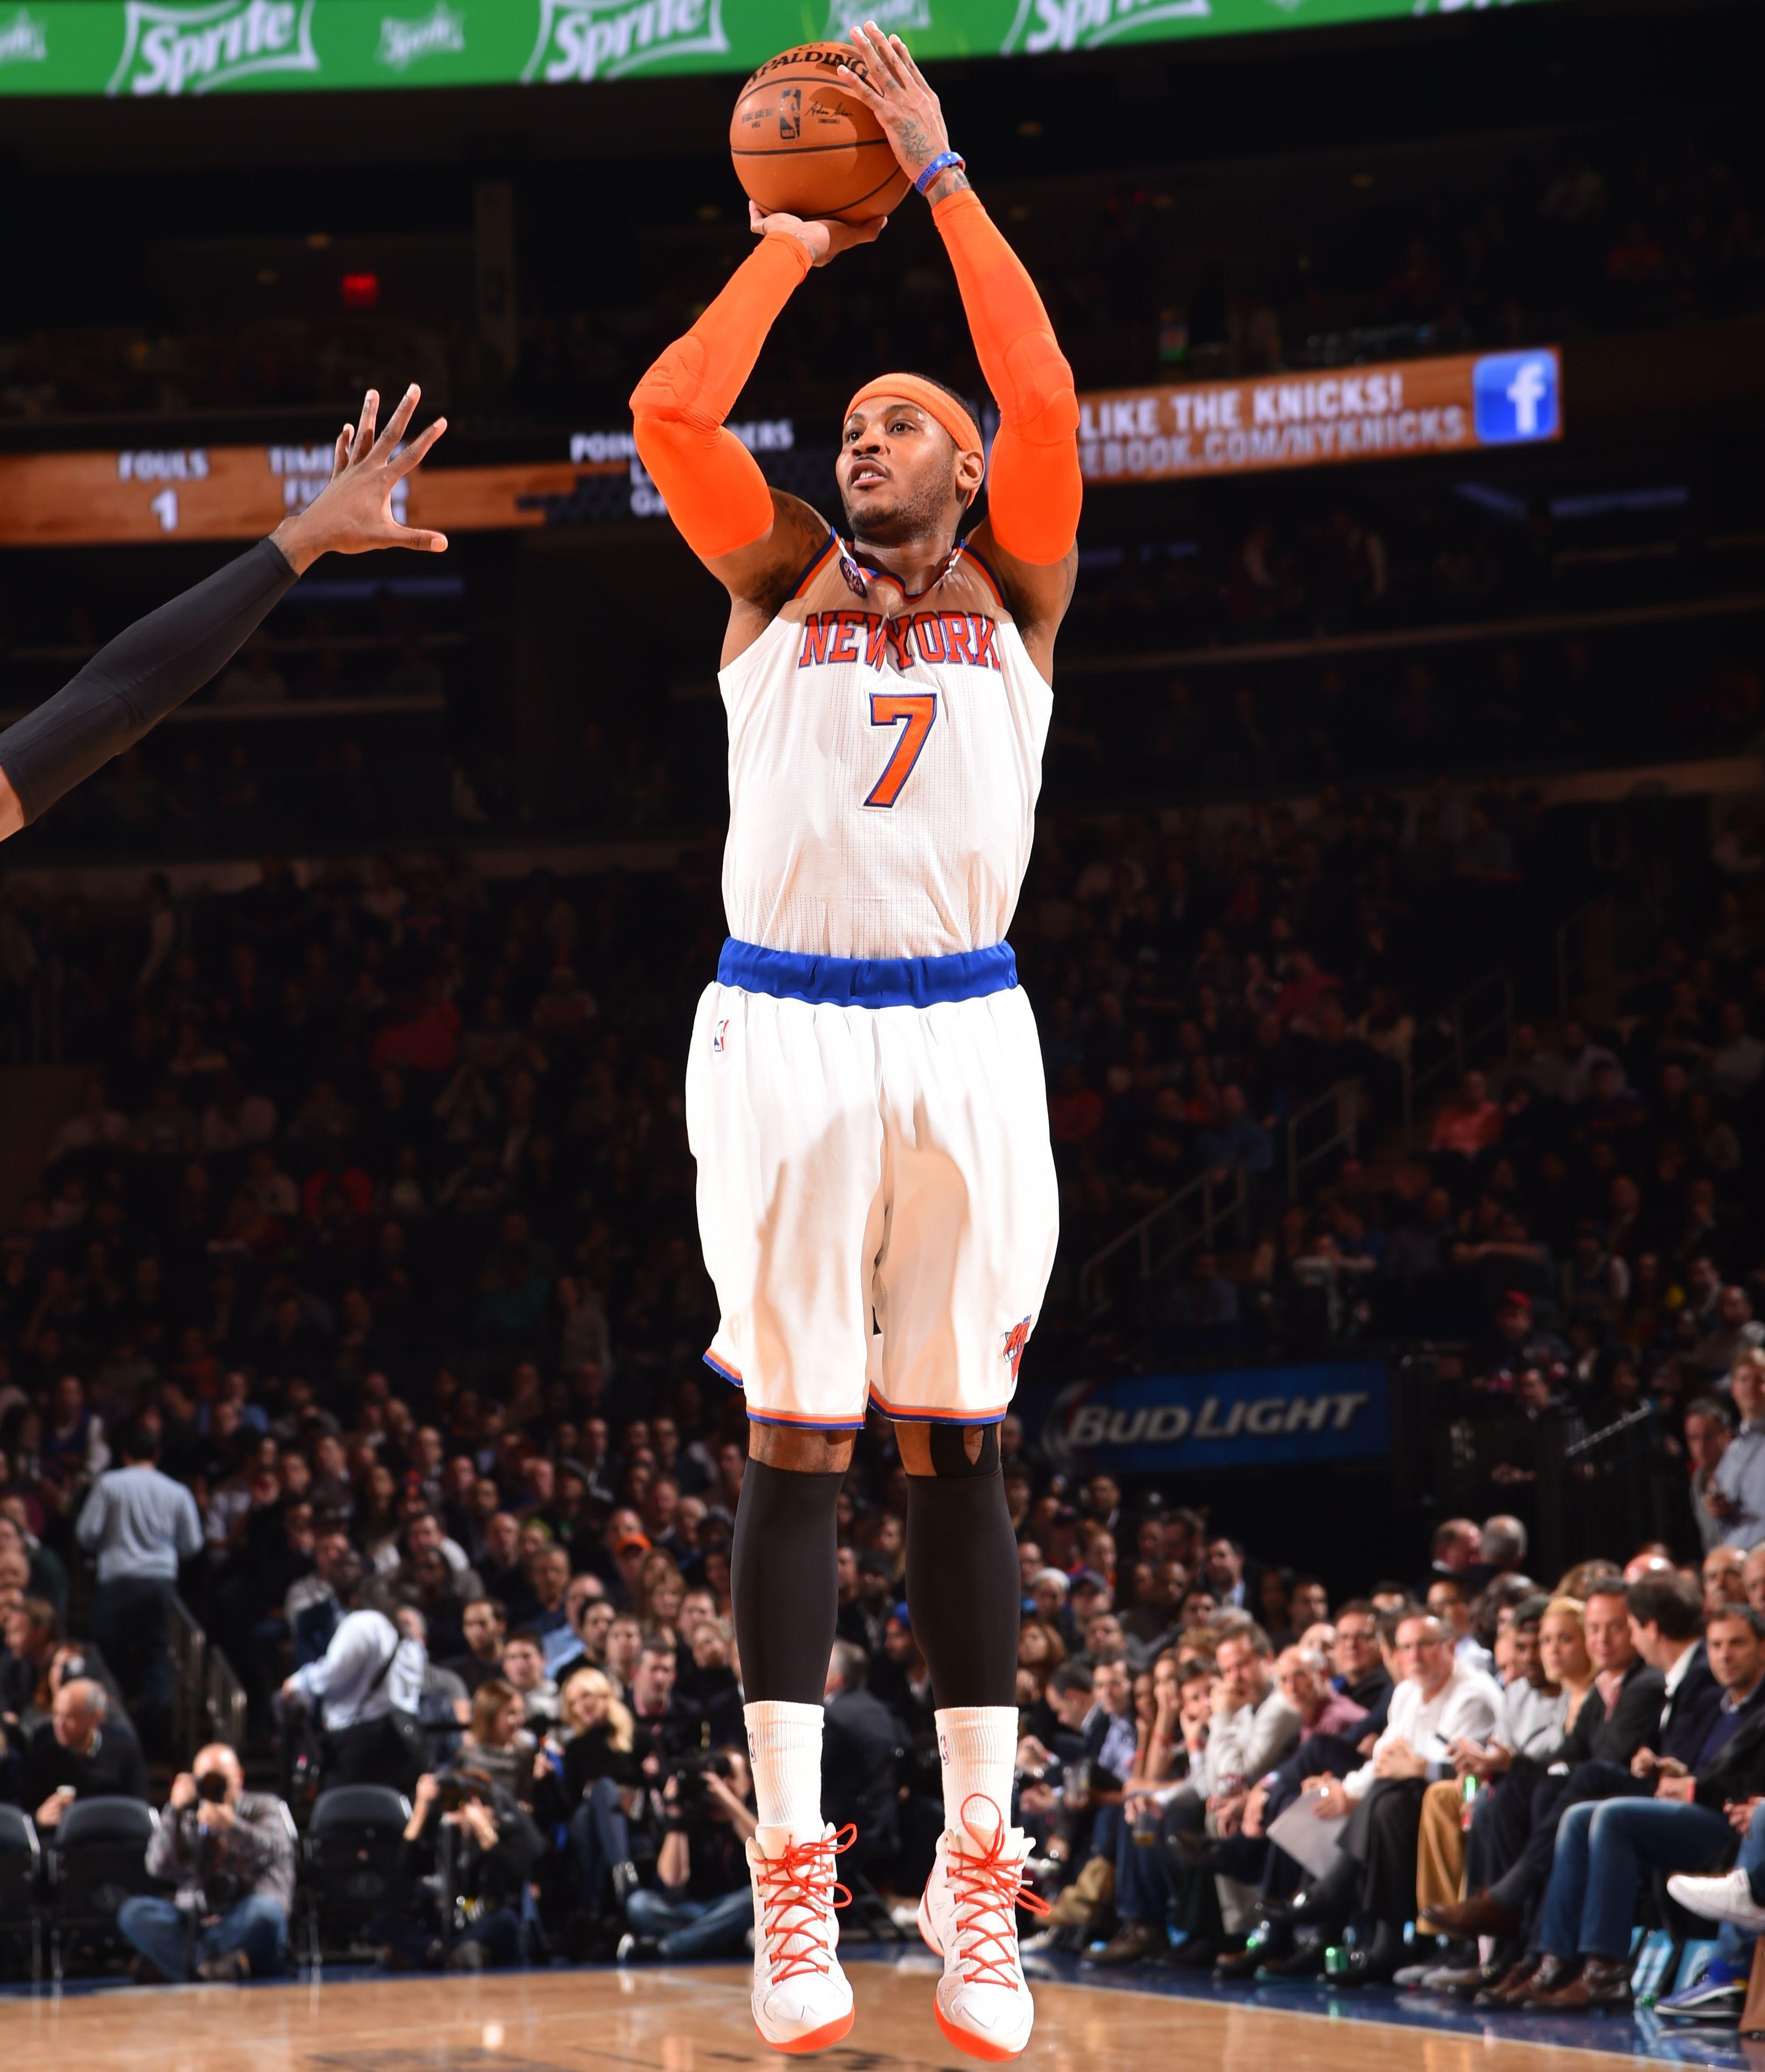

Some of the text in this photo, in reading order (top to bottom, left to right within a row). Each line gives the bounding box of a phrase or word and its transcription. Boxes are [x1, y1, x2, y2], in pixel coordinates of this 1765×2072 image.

[132, 0, 295, 96] Sprite
[546, 0, 707, 84] Sprite
[1079, 372, 1402, 440] LIKE THE KNICKS!
[117, 449, 209, 481] FOULS
[570, 432, 637, 464] POIN
[1078, 405, 1466, 477] EBOOK.COM/NYKNICKS
[152, 488, 178, 531] 1
[798, 610, 1002, 673] NEW YORK
[863, 693, 937, 808] 7
[1070, 1394, 1368, 1446] BUD LIGHT
